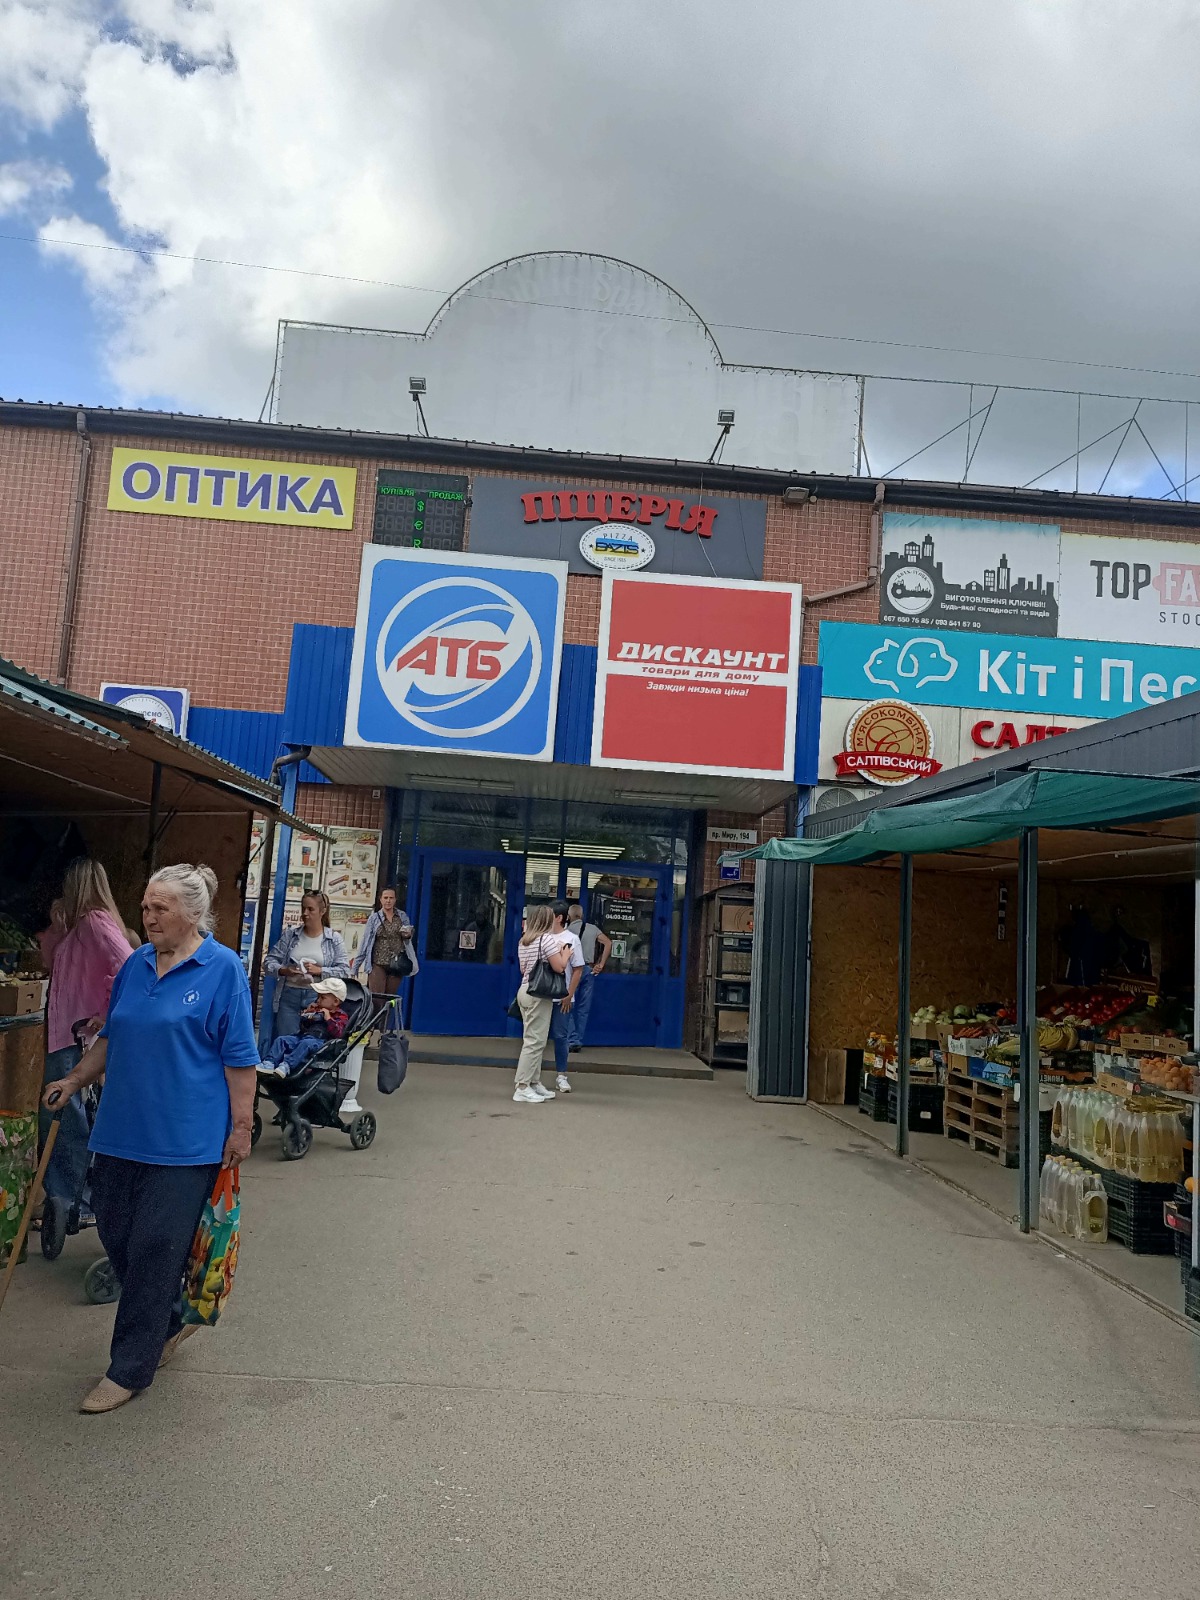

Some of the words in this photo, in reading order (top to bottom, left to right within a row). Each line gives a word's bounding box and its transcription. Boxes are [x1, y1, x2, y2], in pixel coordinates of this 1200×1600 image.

[122, 461, 344, 516] ОПТИКА
[381, 486, 415, 497] КУПІВЛЯ
[428, 491, 464, 501] ПРОДАЖ
[520, 490, 719, 538] ПІЦЕРІЯ
[602, 532, 633, 541] PIZZA
[1090, 559, 1152, 601] TOP
[1165, 568, 1200, 603] FA
[945, 594, 1007, 605] ВИГОТОВЛЕННЯ
[940, 602, 976, 611] Будь-якої
[977, 606, 1019, 615] складності
[1029, 610, 1050, 618] видів
[396, 635, 509, 681] АТБ
[616, 642, 786, 670] ДИСКАУНТ
[641, 665, 690, 677] товари
[694, 669, 720, 679] для
[725, 672, 760, 682] дому
[978, 649, 1057, 697] Кіт
[1073, 656, 1084, 699] і
[1100, 658, 1198, 705] Пес
[646, 681, 686, 692] Завжди
[687, 685, 722, 695] низька
[724, 688, 750, 697] ціна!
[857, 708, 924, 753] М'ЯСОКОМБІНАТ
[846, 755, 932, 773] САЛТІВСЬКИЙ
[711, 831, 721, 839] пр.
